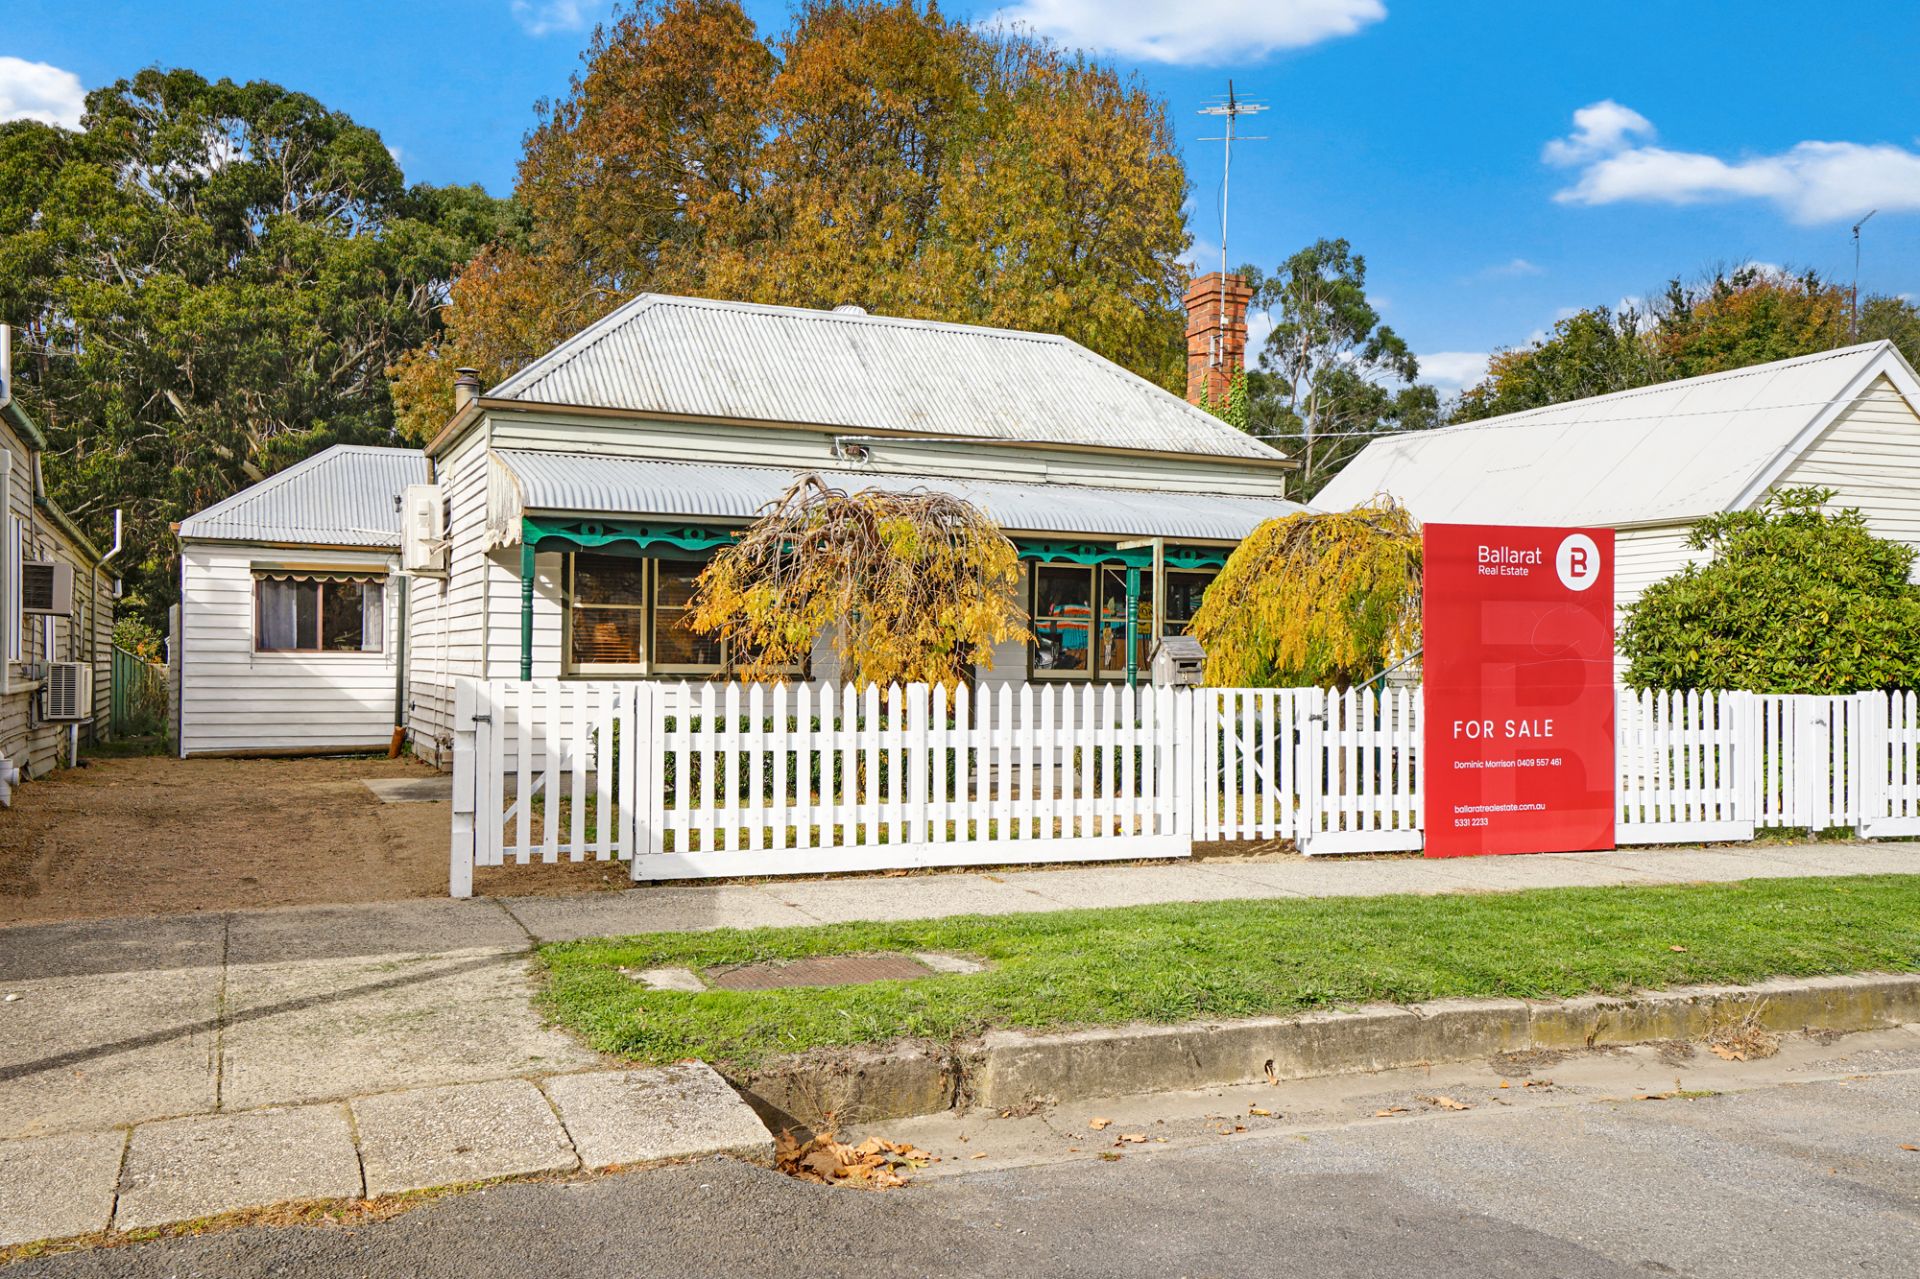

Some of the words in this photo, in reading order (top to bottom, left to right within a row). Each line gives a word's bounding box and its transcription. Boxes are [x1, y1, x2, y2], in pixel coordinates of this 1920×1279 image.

[1478, 545, 1542, 565] Ballarat
[1570, 547, 1588, 578] B
[1478, 565, 1499, 576] Real
[1500, 565, 1529, 576] Estate
[1453, 720, 1494, 739] FOR
[1504, 719, 1553, 738] SALE
[1454, 760, 1484, 769] Dominic
[1485, 759, 1515, 768] Morrison
[1517, 758, 1535, 767] 0409
[1536, 757, 1549, 766] 557
[1550, 757, 1562, 766] 461
[1454, 803, 1545, 813] ballaratrealestate.com.au
[1454, 818, 1470, 827] 5331
[1471, 817, 1488, 826] 2233
